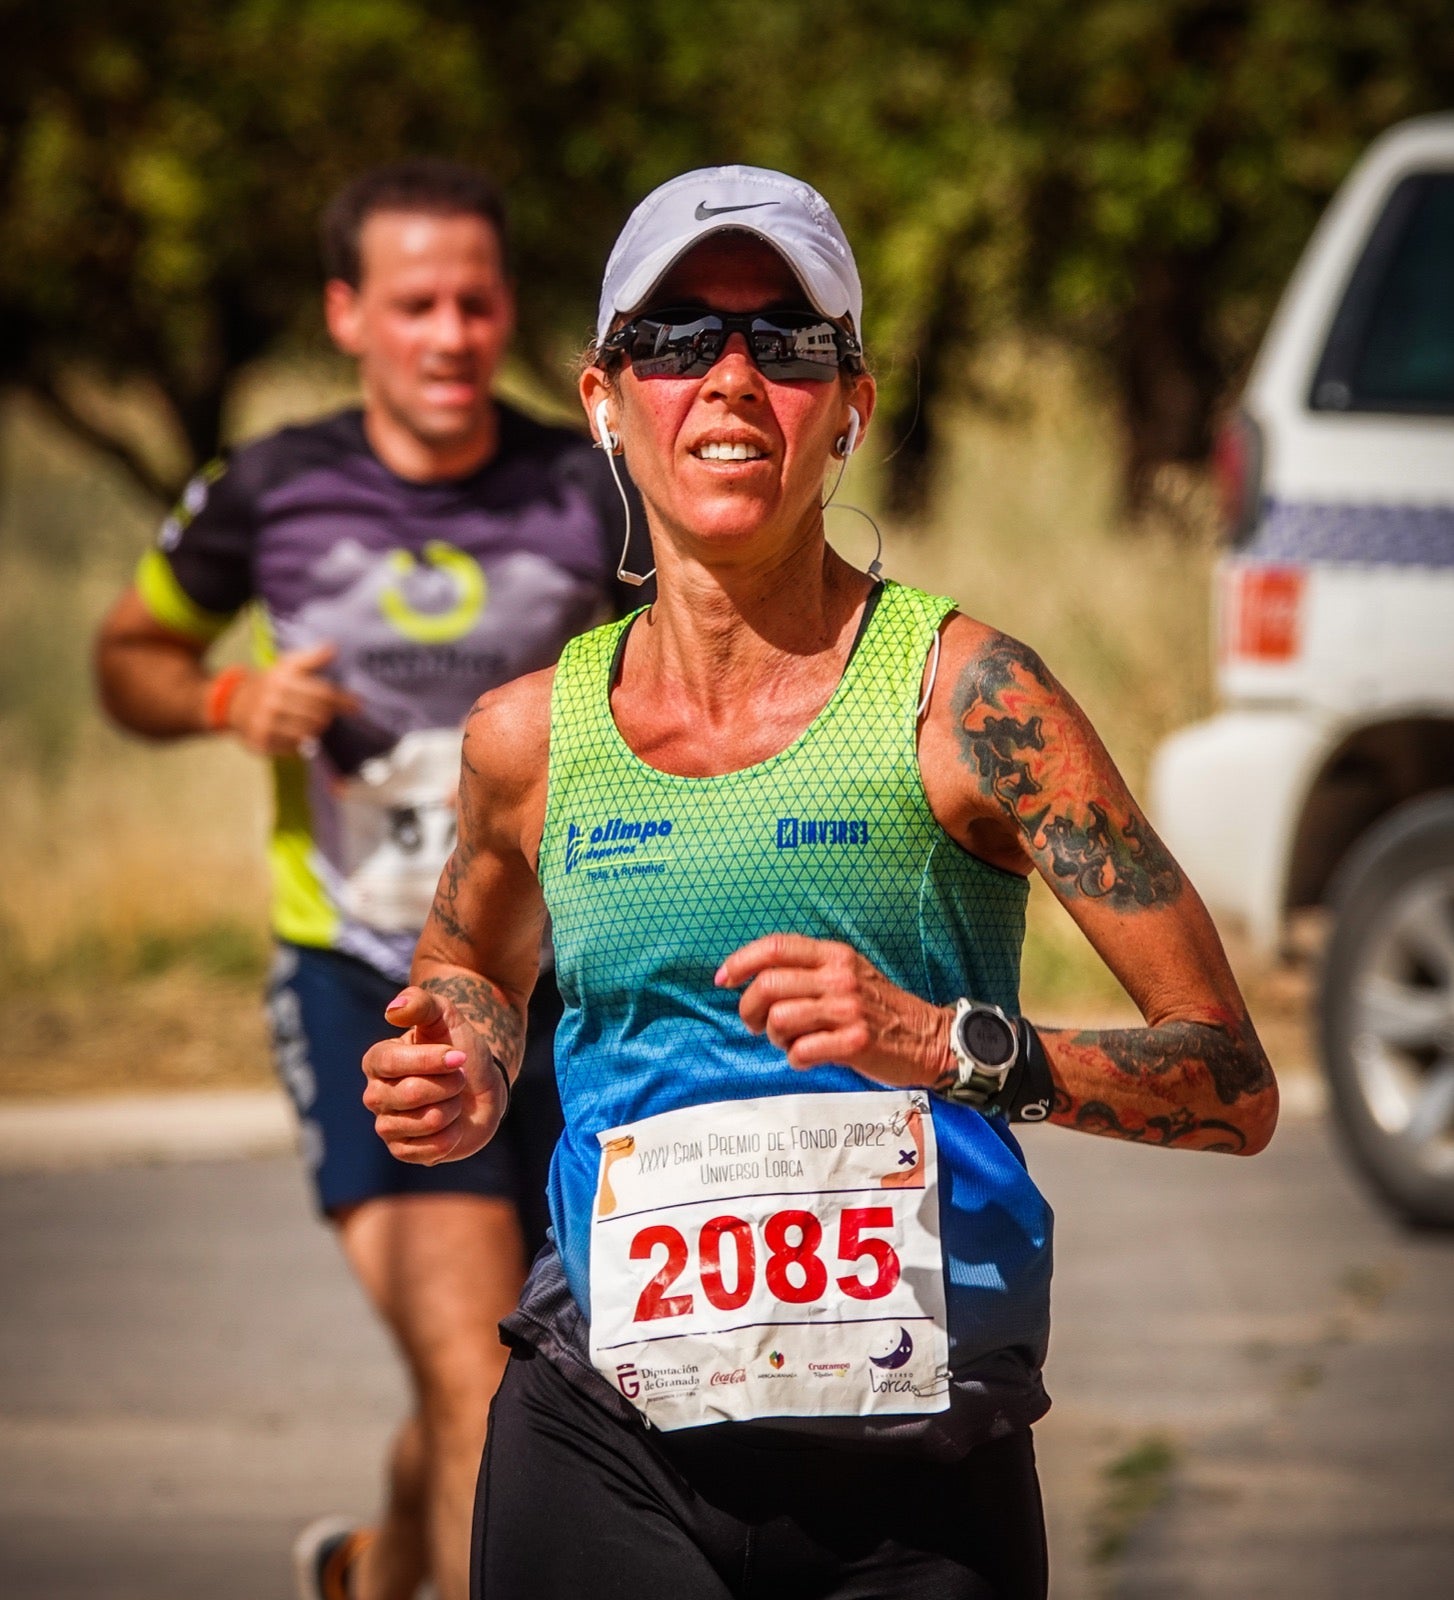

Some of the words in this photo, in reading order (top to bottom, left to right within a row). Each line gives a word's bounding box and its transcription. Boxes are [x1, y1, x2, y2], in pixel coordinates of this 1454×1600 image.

[590, 818, 673, 843] olimpo
[621, 864, 665, 876] RUNNING
[638, 1146, 668, 1175] XXXV
[673, 1141, 703, 1166] GRAN
[708, 1132, 761, 1158] PREMIO
[767, 1130, 786, 1151] DE
[790, 1125, 838, 1150] FONDO
[843, 1122, 886, 1148] 2022
[700, 1164, 760, 1185] UNIVERSO
[764, 1158, 804, 1178] LORCA
[628, 1206, 902, 1324] 2085
[641, 1364, 699, 1379] Diputación
[808, 1362, 851, 1371] Cruzcampo
[655, 1377, 700, 1388] Granada
[869, 1368, 911, 1394] Lorca
